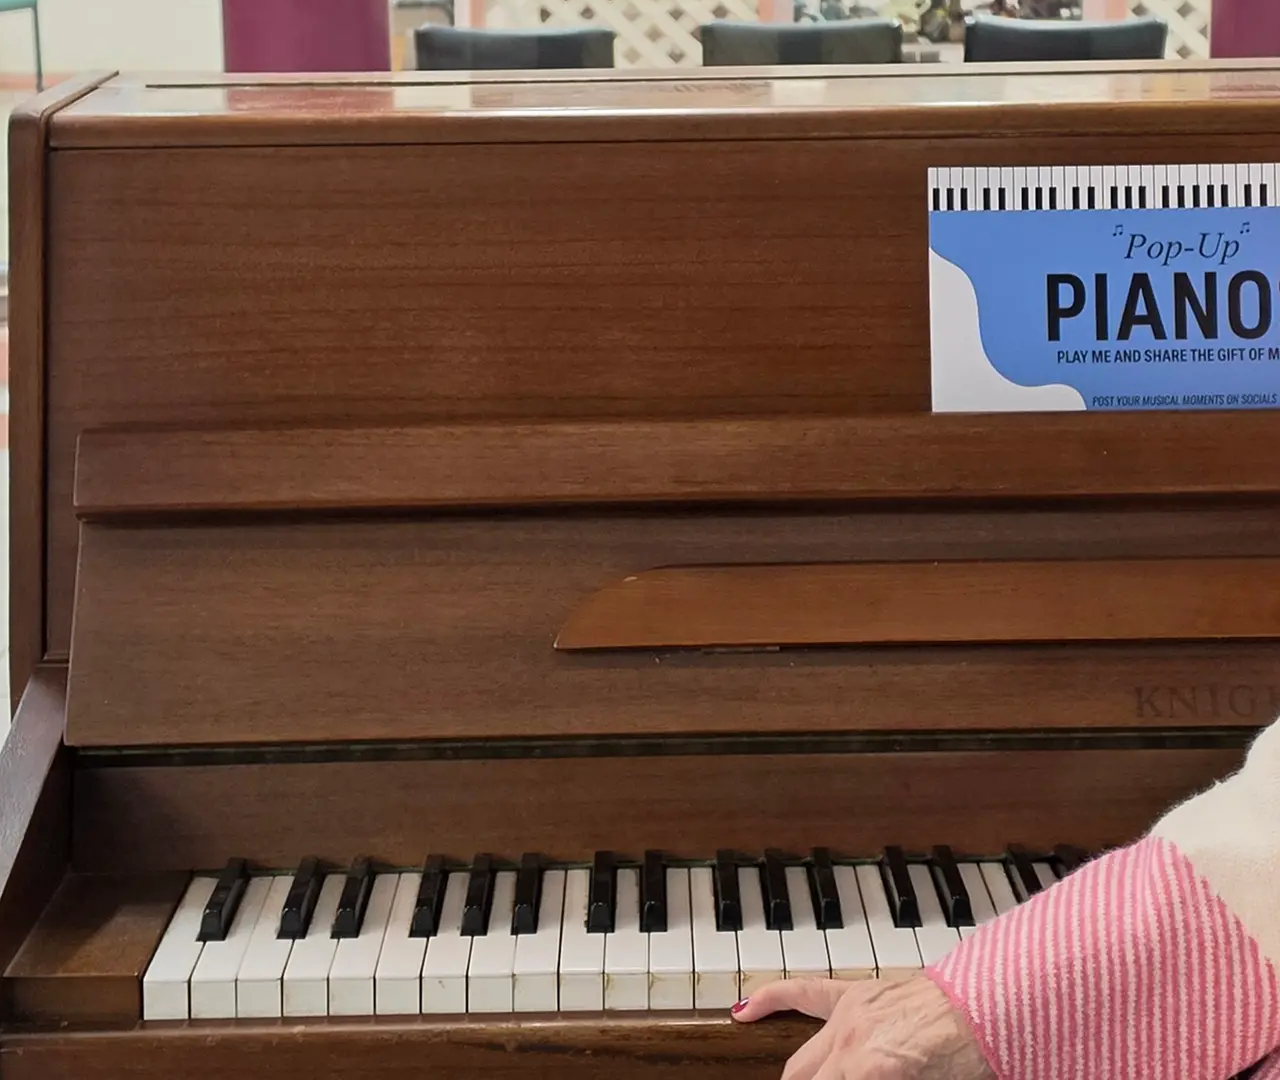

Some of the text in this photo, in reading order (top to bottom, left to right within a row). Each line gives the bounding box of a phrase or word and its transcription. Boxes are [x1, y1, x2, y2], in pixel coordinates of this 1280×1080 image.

[1124, 233, 1239, 266] Pop-Up
[1057, 349, 1088, 364] PLAY
[1092, 349, 1111, 363] ME
[1114, 349, 1141, 363] AND
[1144, 349, 1187, 362] SHARE
[1190, 348, 1214, 362] THE
[1218, 347, 1245, 362] GIFT
[1249, 347, 1265, 361] OF
[1092, 393, 1278, 407] POST YOUR MUSICAL MOMENTS ON SOCIALS
